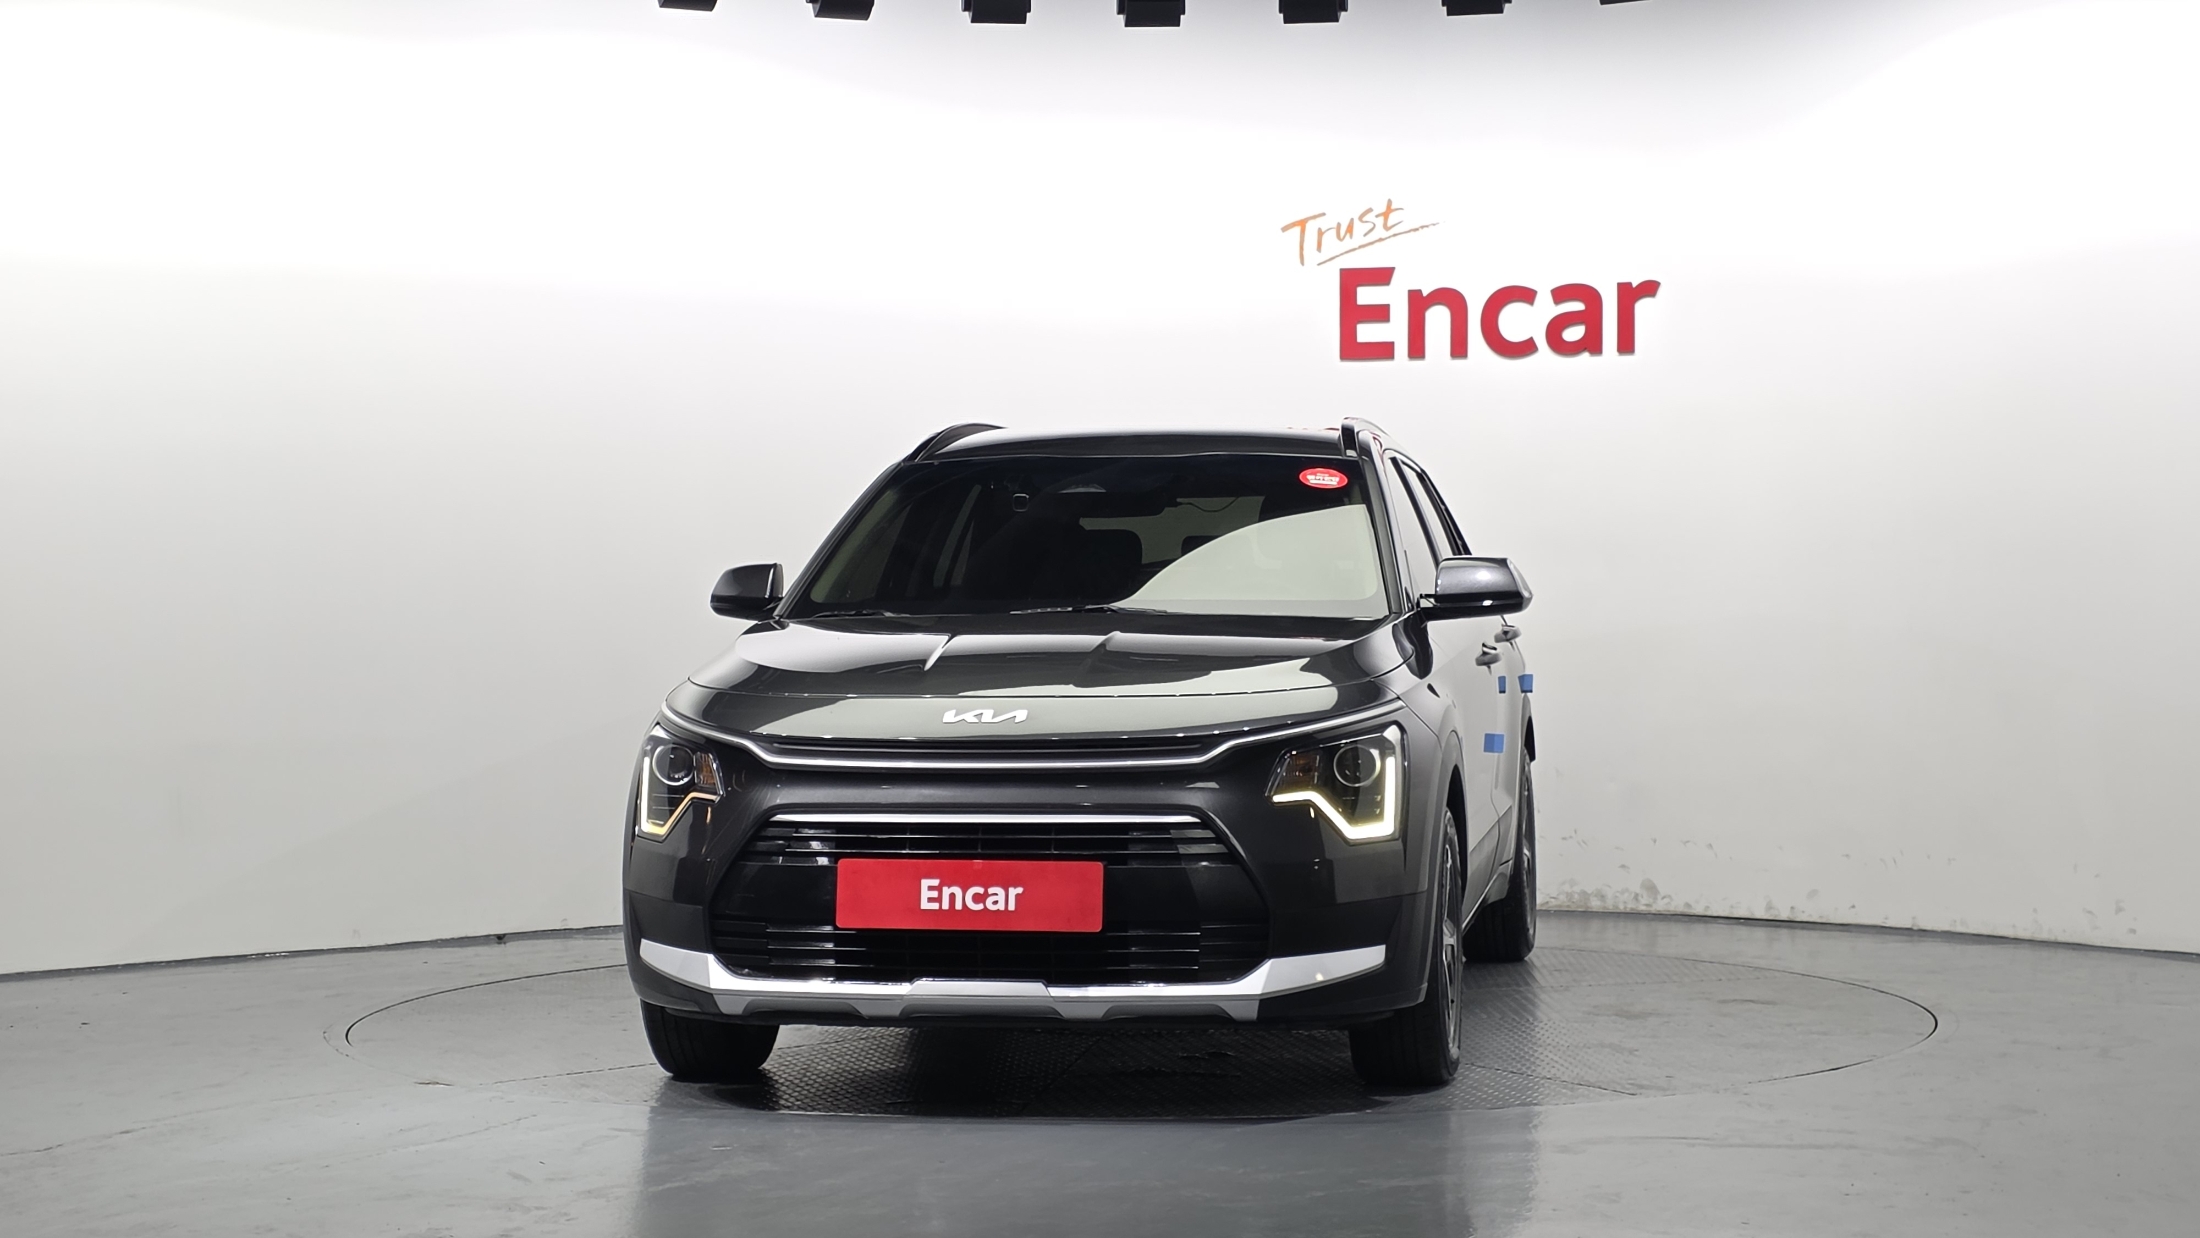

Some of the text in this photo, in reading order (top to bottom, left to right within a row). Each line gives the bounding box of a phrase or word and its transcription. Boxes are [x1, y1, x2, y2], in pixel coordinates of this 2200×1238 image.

[1281, 199, 1404, 266] Trust
[1339, 267, 1661, 361] Encar
[920, 878, 1023, 911] Encar
